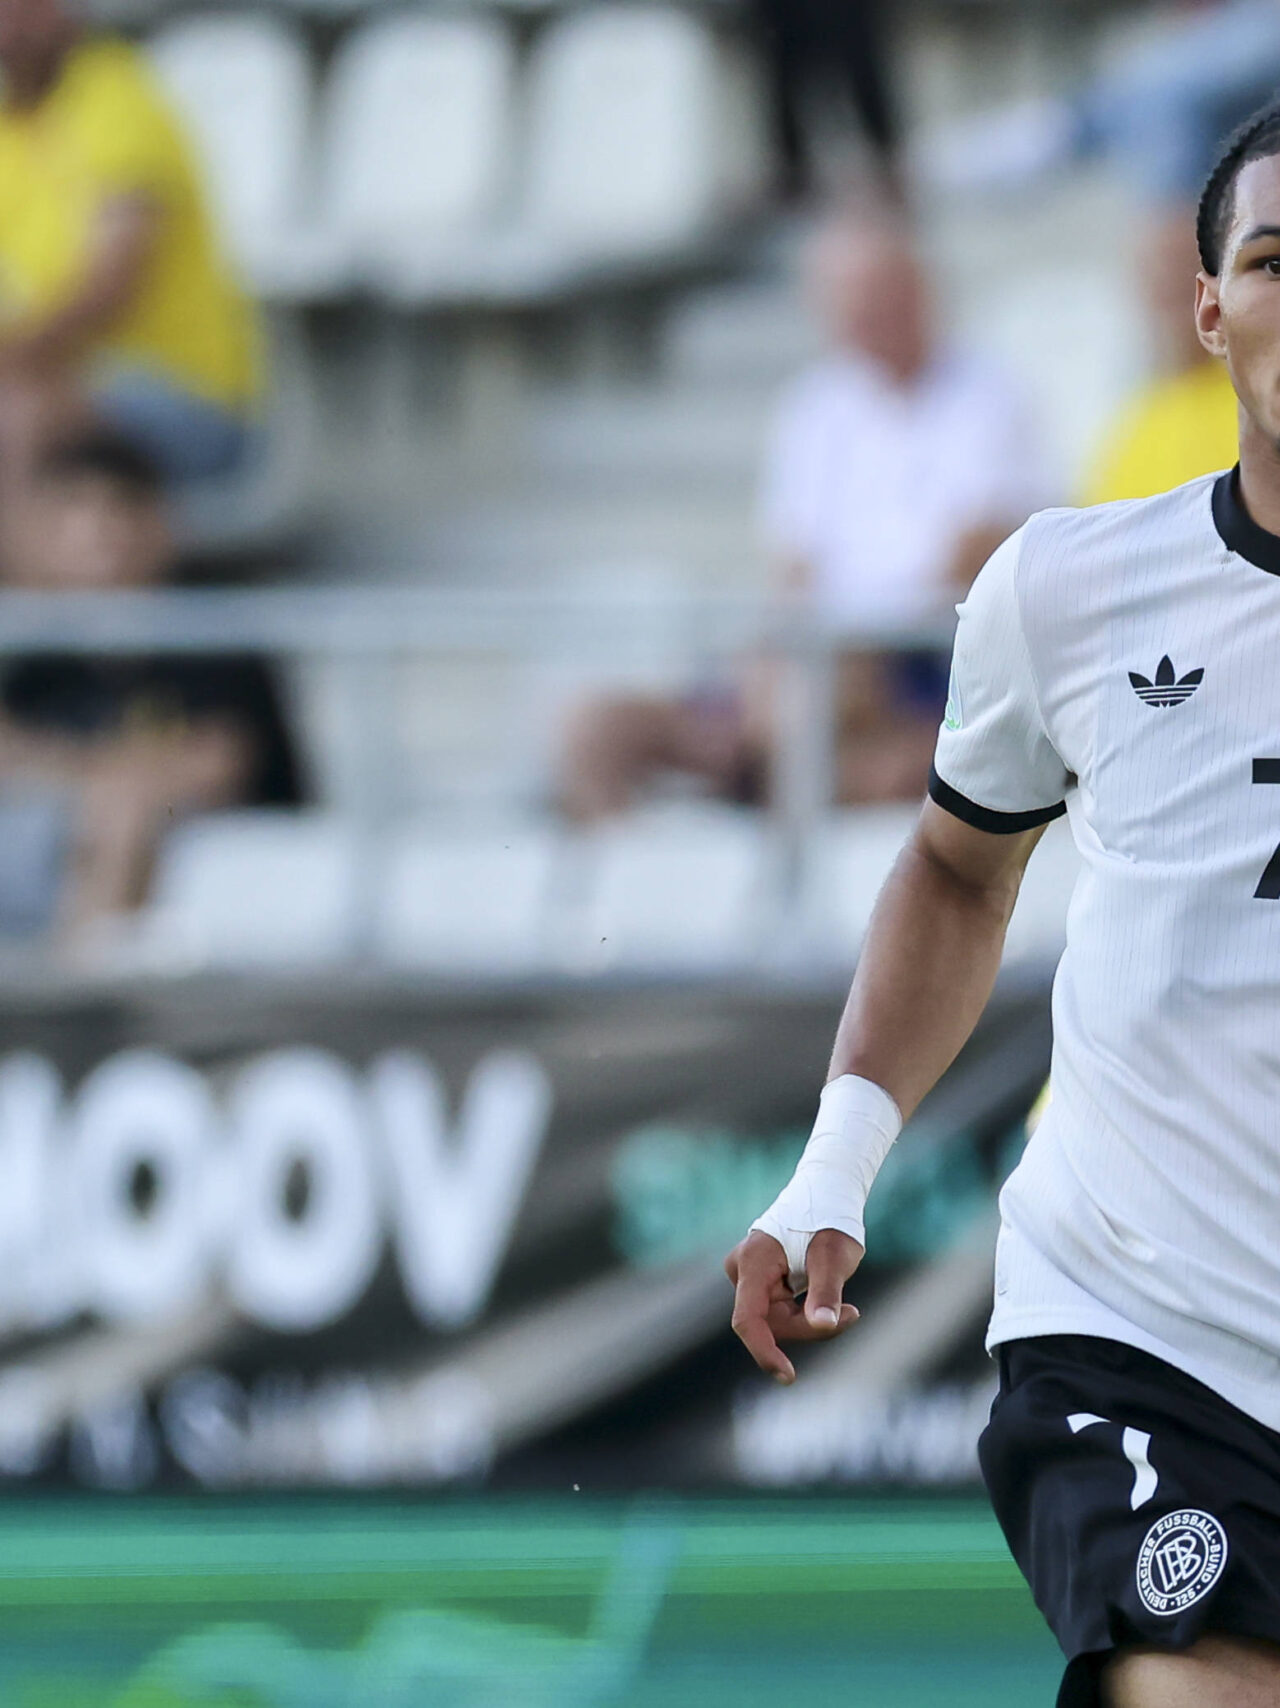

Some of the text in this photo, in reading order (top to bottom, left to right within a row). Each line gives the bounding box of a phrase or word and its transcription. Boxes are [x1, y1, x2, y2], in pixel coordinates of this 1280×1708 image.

[1066, 1412, 1158, 1511] 7
[1140, 1537, 1168, 1610] DEUTSCHER
[1175, 1587, 1196, 1607] 125
